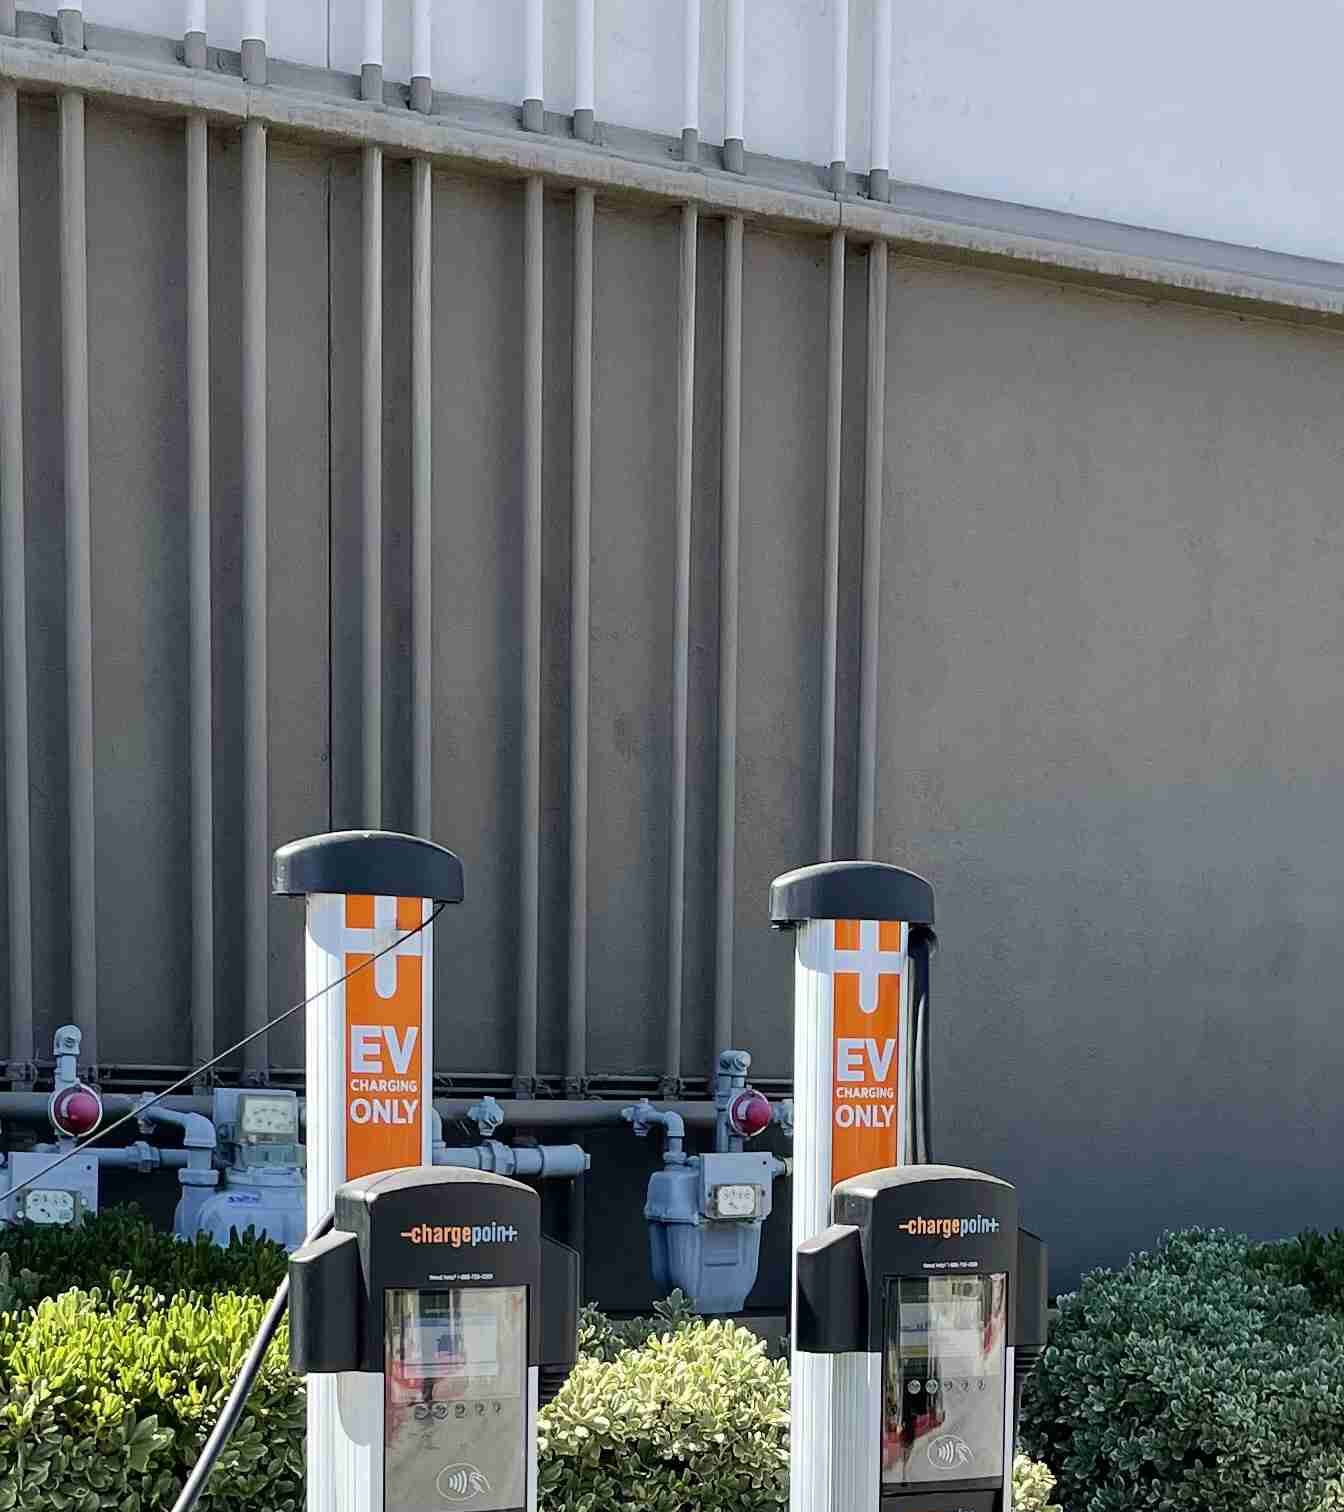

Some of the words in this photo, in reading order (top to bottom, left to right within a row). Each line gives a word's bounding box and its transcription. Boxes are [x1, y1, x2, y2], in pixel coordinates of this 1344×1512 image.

[350, 1025, 419, 1074] EV
[836, 1038, 896, 1082] EV
[350, 1079, 418, 1092] CHARGING
[836, 1087, 894, 1099] CHARGING
[350, 1098, 419, 1124] ONLY
[835, 1104, 896, 1128] ONLY
[401, 1221, 518, 1248] chargepoint
[899, 1215, 1000, 1237] chargepoint
